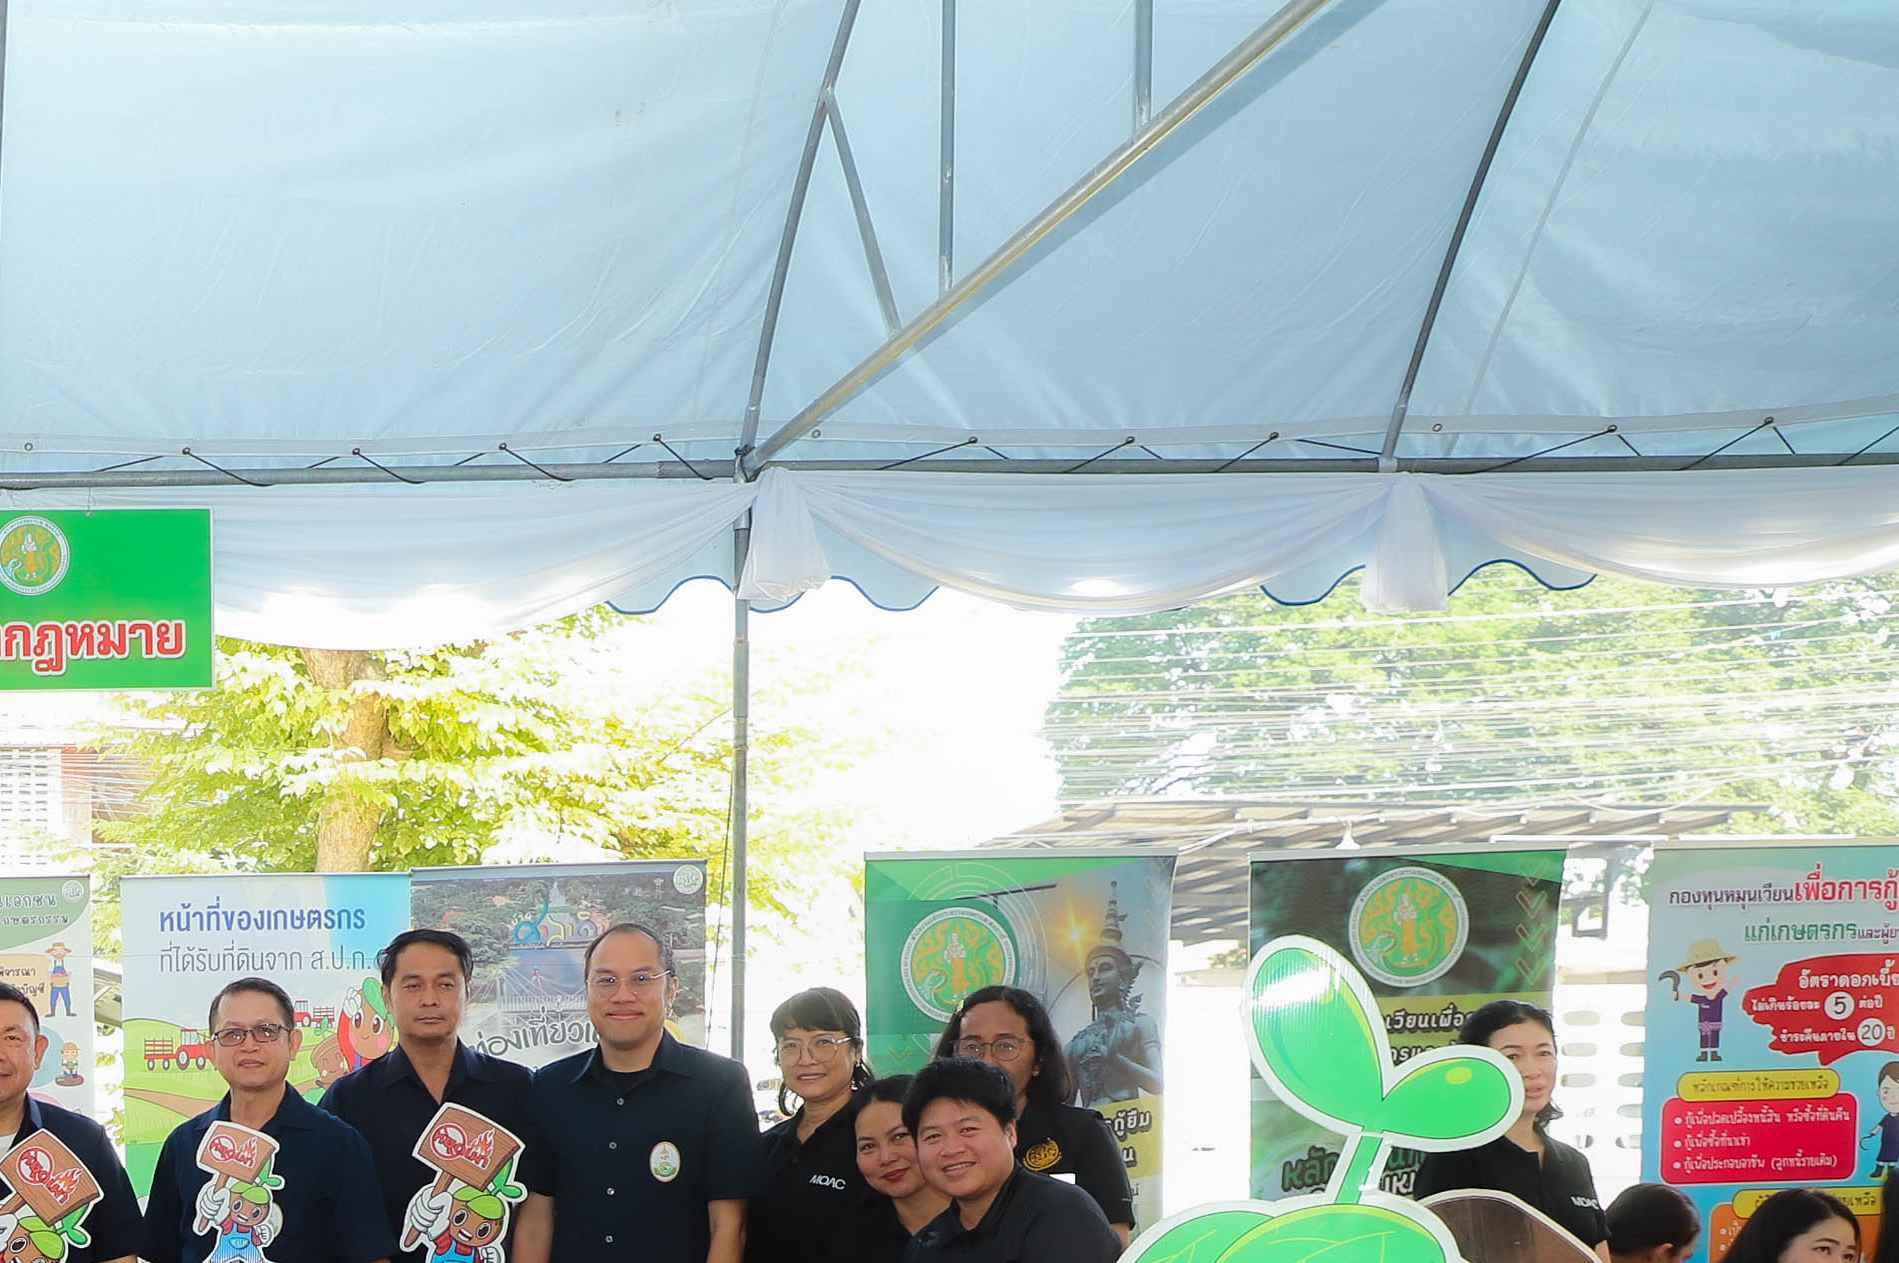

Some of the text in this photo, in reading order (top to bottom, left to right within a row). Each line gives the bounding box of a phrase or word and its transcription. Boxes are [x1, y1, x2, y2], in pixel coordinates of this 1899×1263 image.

[160, 896, 366, 932] หน้าที่ของเกษตรกร
[160, 940, 372, 973] ที่ได้รับที่ดินจาก ส.ป.ก.
[1834, 997, 1846, 1015] 5
[1862, 1024, 1882, 1040] 20
[1107, 1108, 1151, 1137] กู้ยืม
[809, 1174, 846, 1190] MOAC
